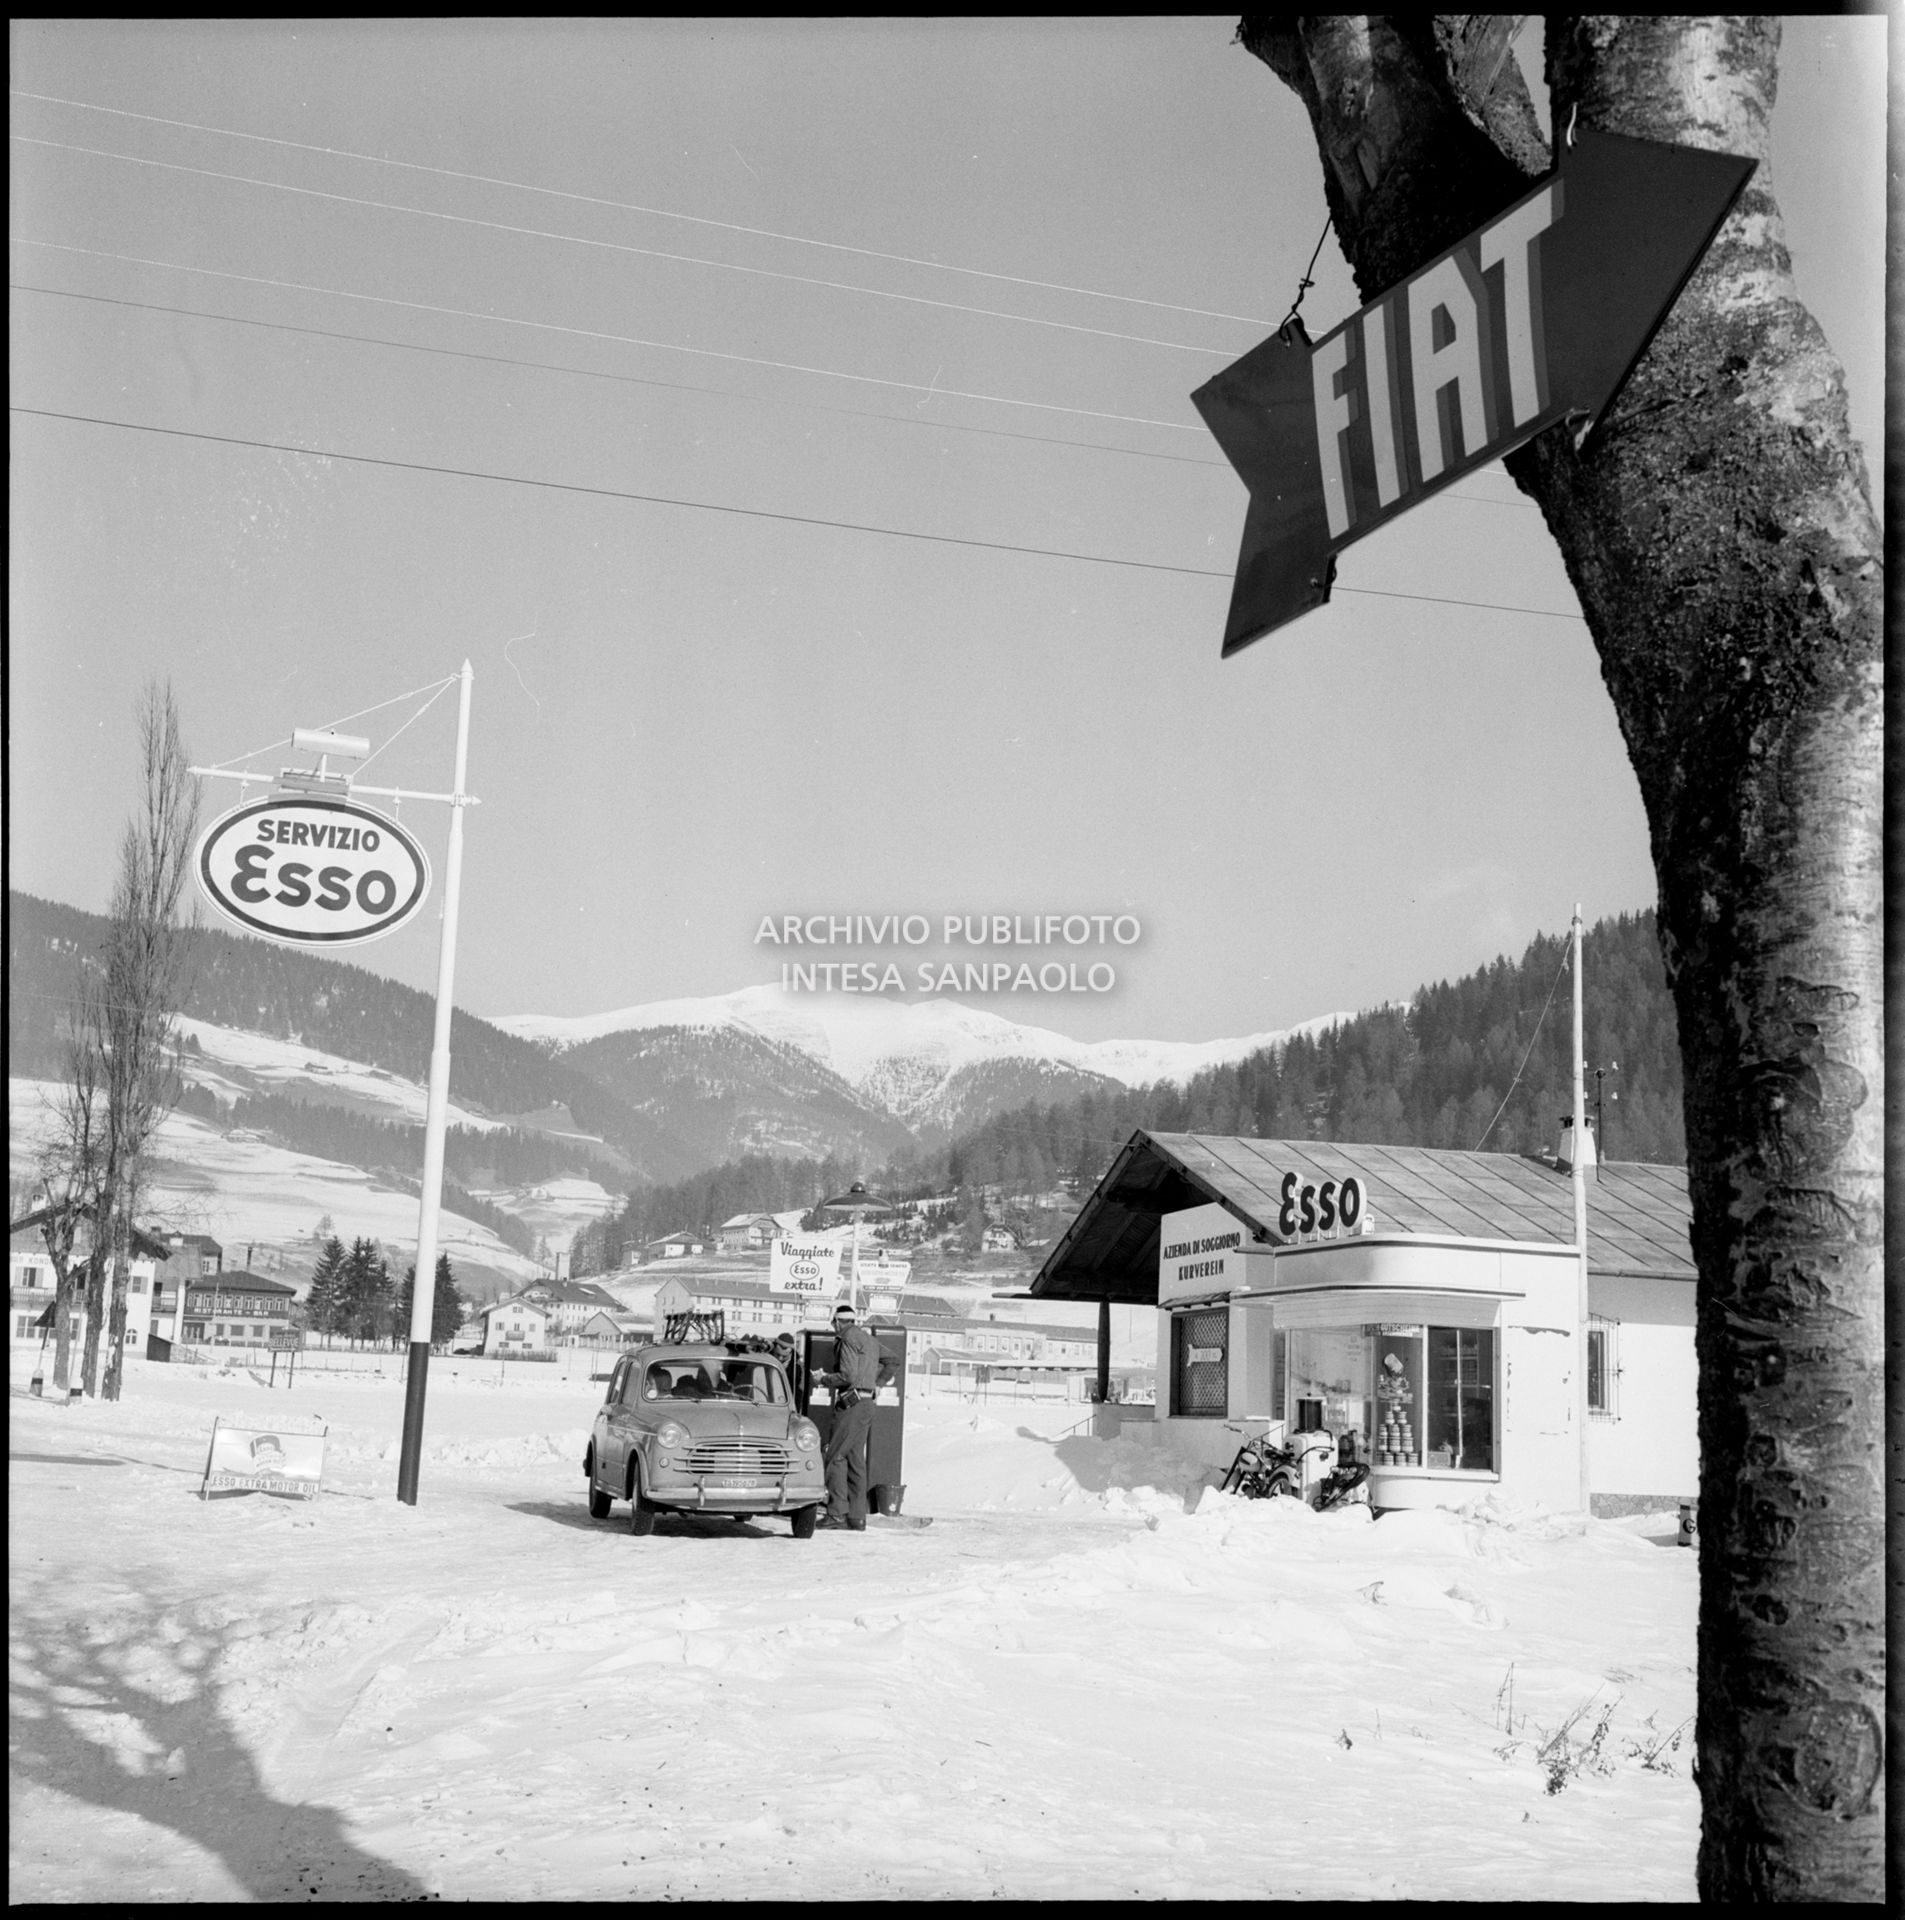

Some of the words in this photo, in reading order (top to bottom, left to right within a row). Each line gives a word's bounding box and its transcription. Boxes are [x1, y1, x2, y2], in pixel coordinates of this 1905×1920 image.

[1311, 184, 1558, 540] FIAT
[256, 819, 380, 852] SERVIZIO
[780, 1241, 834, 1260] Viaggiate
[1163, 1242, 1191, 1260] AZIENDA
[1192, 1240, 1201, 1256] DI
[1201, 1231, 1241, 1253] SOGGIORNO
[1178, 1259, 1225, 1281] KURVEREIN
[784, 1277, 823, 1291] extra!
[194, 1307, 243, 1316] RISTORANTE
[211, 1476, 236, 1487] ESSO
[239, 1479, 267, 1489] EXTRA
[269, 1481, 300, 1492] MOTOR
[302, 1483, 319, 1494] OIL
